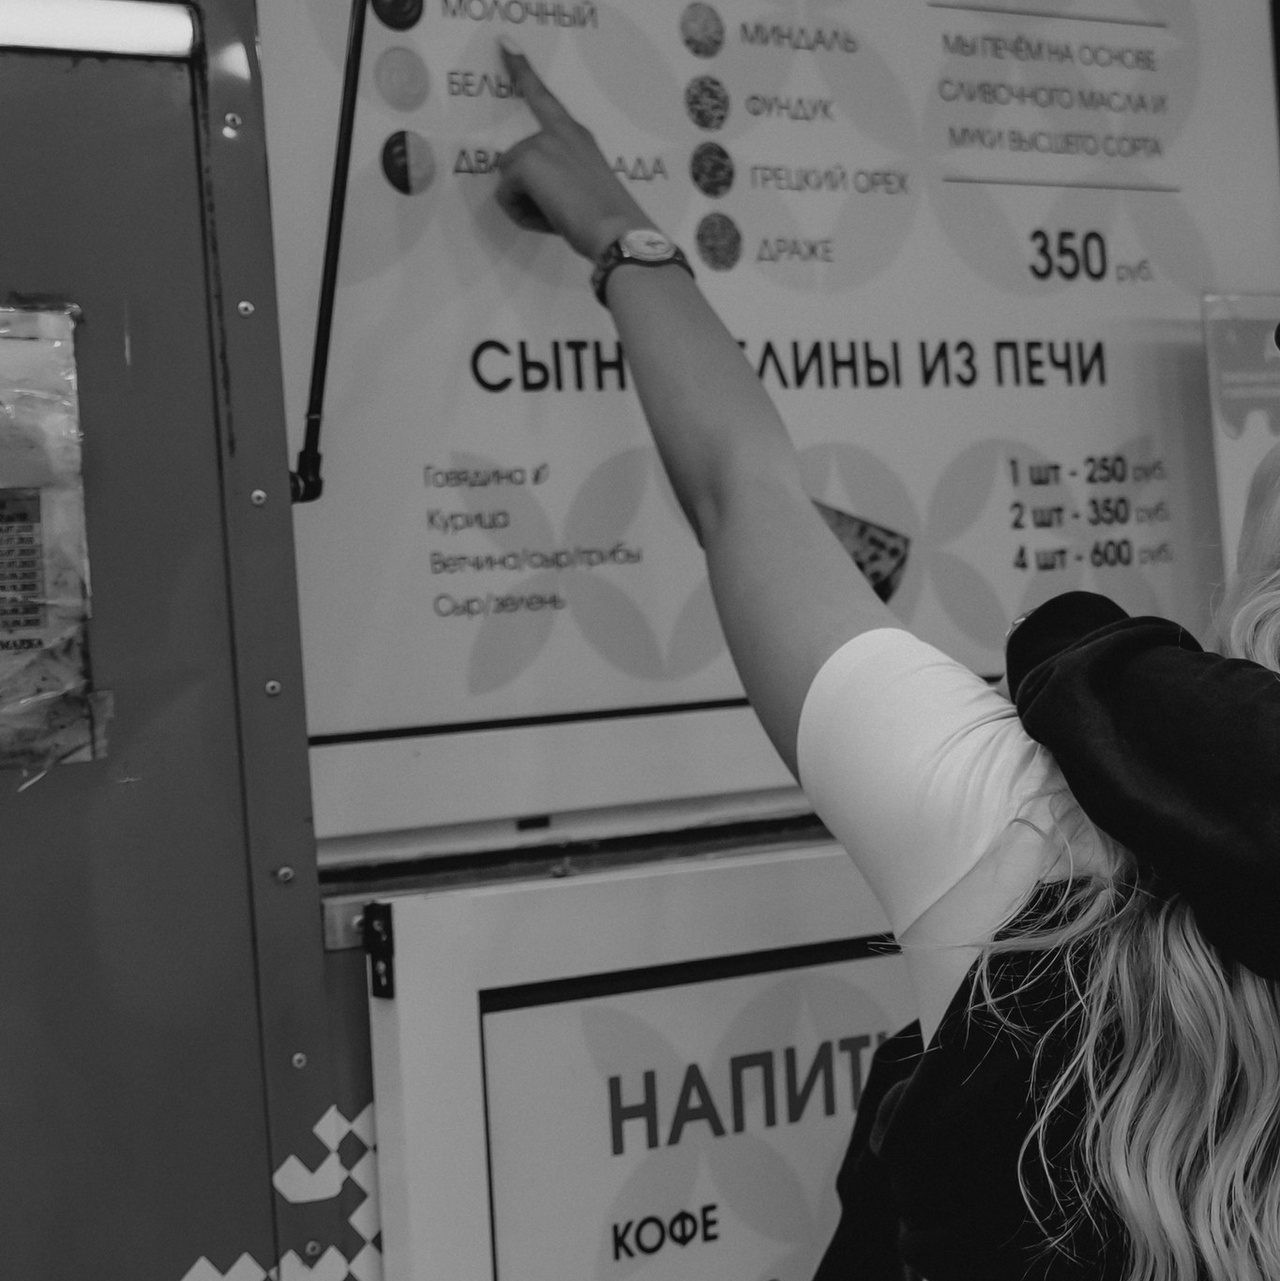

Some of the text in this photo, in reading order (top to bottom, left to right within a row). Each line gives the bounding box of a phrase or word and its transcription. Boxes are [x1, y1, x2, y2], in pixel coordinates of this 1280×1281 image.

[740, 22, 859, 54] МИНДАЛЬ
[446, 71, 524, 99] БЕЛЫ
[745, 93, 835, 121] ФУНДУК
[750, 163, 910, 195] ГРЕЦКИЙ ОРЕХ
[755, 238, 835, 264] ДРАЖЕ
[1029, 228, 1107, 282] 350
[470, 339, 1108, 392] СЫТН ЛИНЫ ИЗ ПЕЧИ
[1010, 458, 1019, 487] 1
[1029, 464, 1061, 485] шт
[1085, 454, 1127, 483] 250
[1010, 501, 1025, 529] 2
[1032, 506, 1064, 528] шт
[1088, 497, 1130, 526] 350
[1013, 545, 1028, 570] 4
[1035, 548, 1067, 571] шт
[1090, 539, 1132, 567] 600
[607, 1031, 887, 1156] НАПИТ
[611, 1204, 719, 1261] КОФЕ
